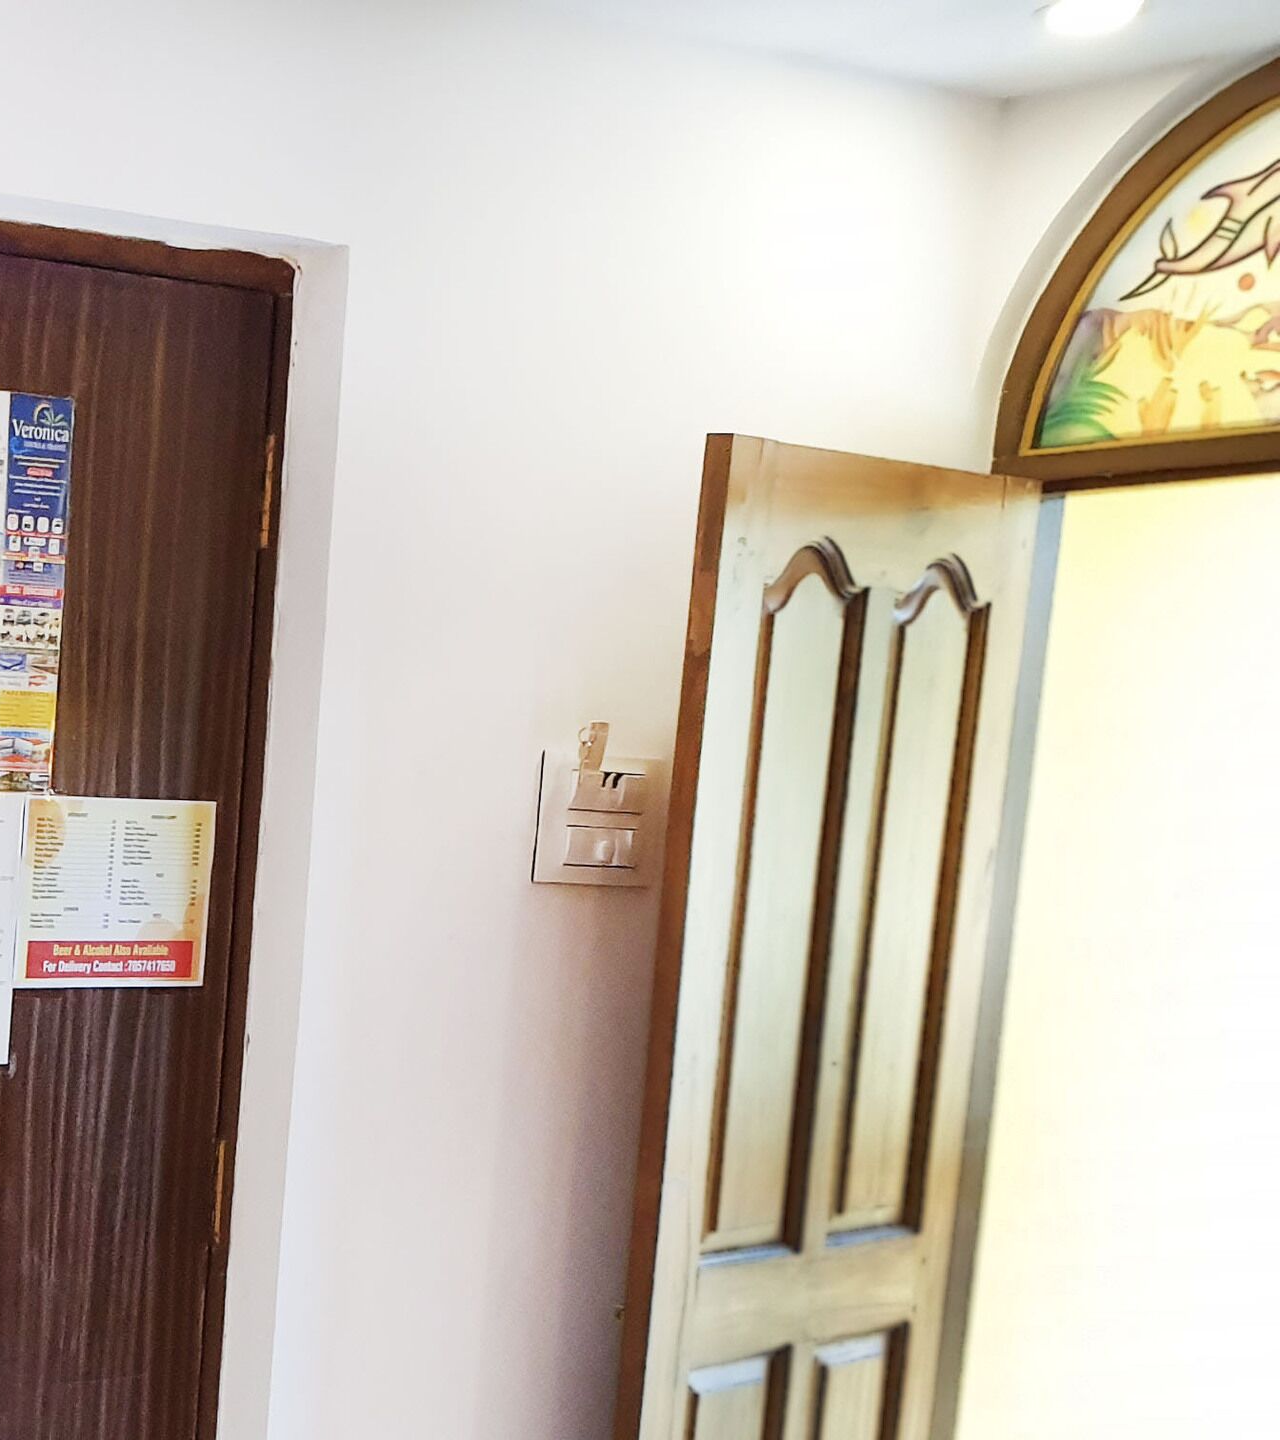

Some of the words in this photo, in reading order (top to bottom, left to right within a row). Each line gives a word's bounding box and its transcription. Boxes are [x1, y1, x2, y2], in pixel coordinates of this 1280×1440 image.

[11, 418, 70, 443] Veronica
[52, 944, 73, 956] Beer
[74, 944, 81, 956] &
[82, 944, 113, 956] Alcohol
[114, 944, 132, 956] Also
[133, 944, 169, 956] Available
[42, 960, 57, 973] For
[58, 960, 92, 974] Delivery
[92, 960, 124, 973] Contact
